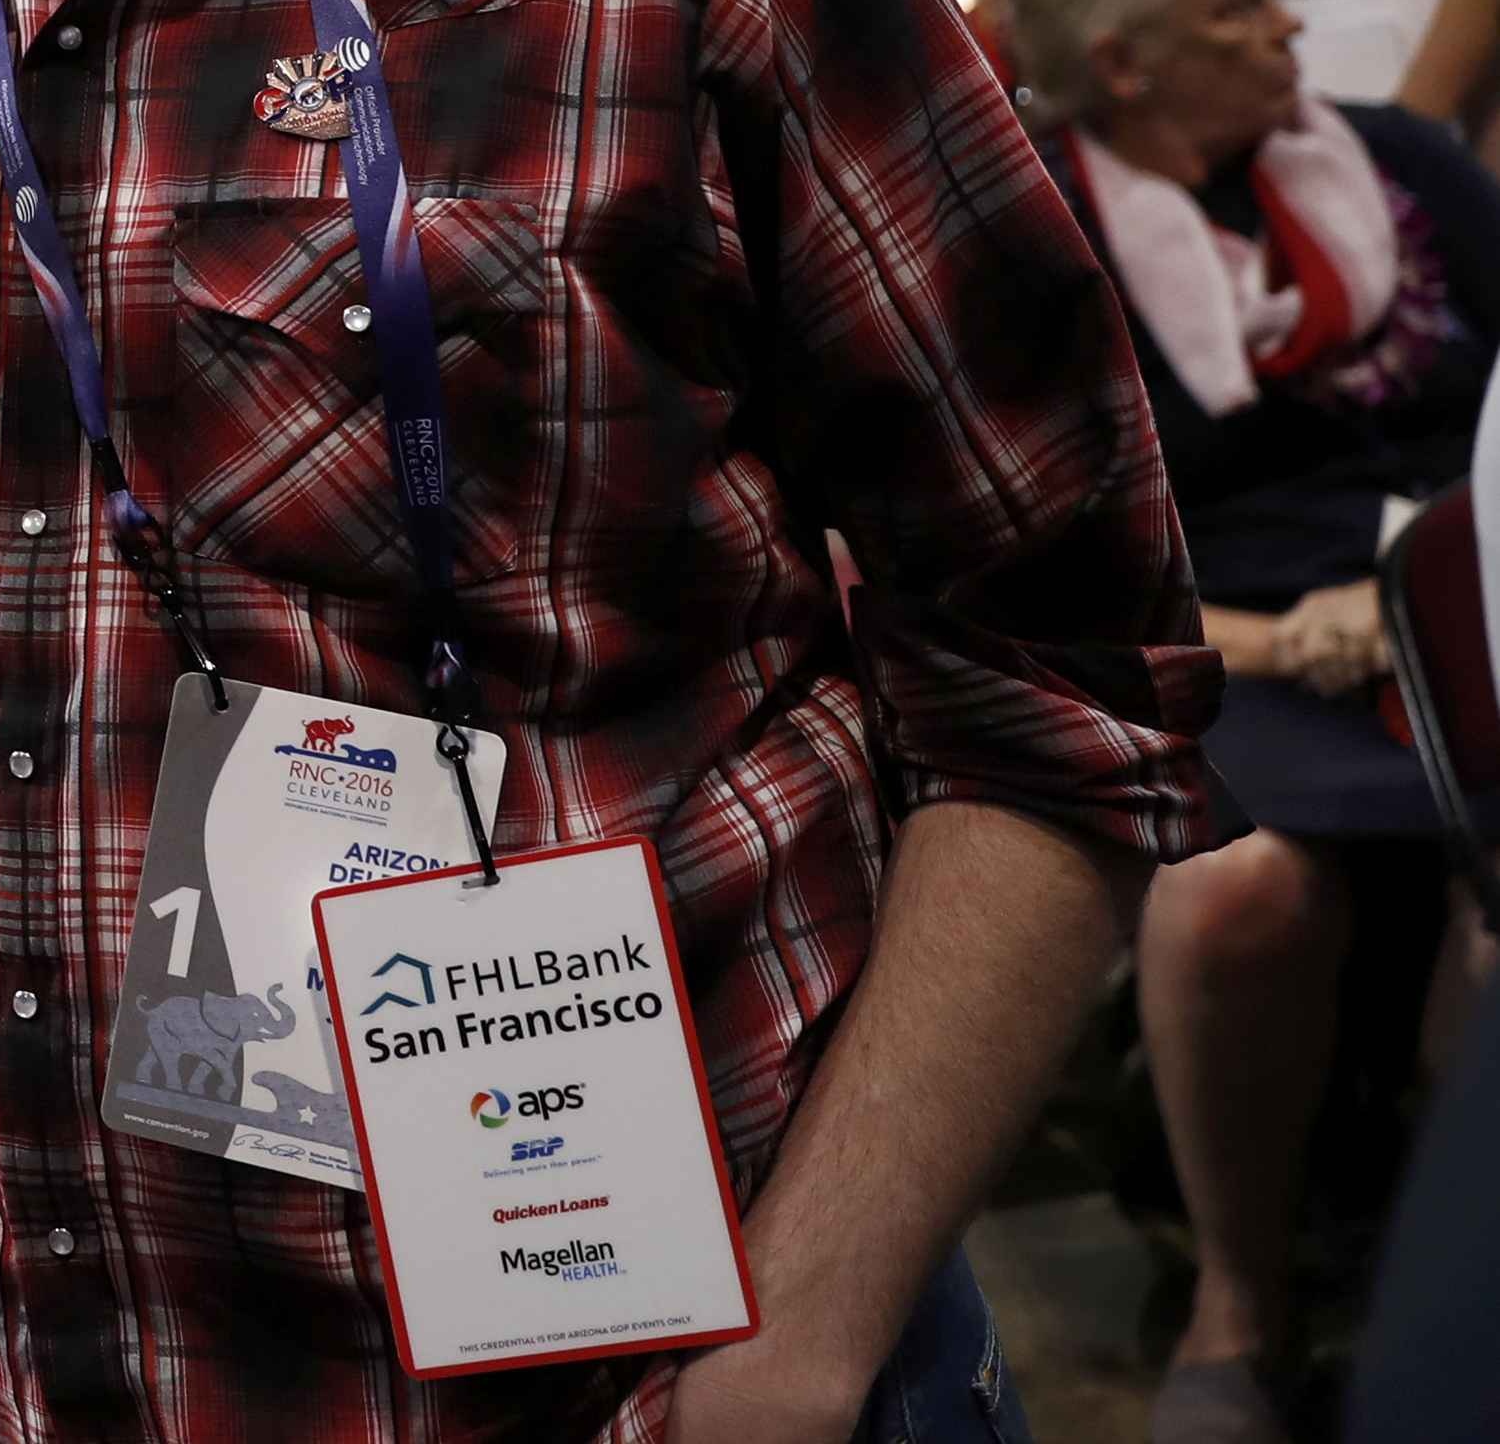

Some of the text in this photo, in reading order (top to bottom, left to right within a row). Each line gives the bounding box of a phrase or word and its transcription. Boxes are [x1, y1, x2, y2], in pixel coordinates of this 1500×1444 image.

[402, 420, 428, 507] CLEVELAND
[286, 782, 391, 812] CLEVELAND
[150, 886, 200, 978] 1
[446, 934, 651, 1000] FHLBank
[365, 992, 663, 1063] San Francisco
[493, 1196, 610, 1224] Quicken Loans
[500, 1240, 615, 1286] Magellan
[562, 1262, 619, 1282] HEALTH
[459, 1345, 480, 1355] THIS
[481, 1337, 536, 1352] CREDENTIAL
[537, 1335, 546, 1344] IS
[547, 1331, 566, 1343] FOR
[568, 1327, 609, 1340] ARIZONA
[610, 1323, 630, 1334] GOP
[631, 1319, 666, 1332] EVENTS
